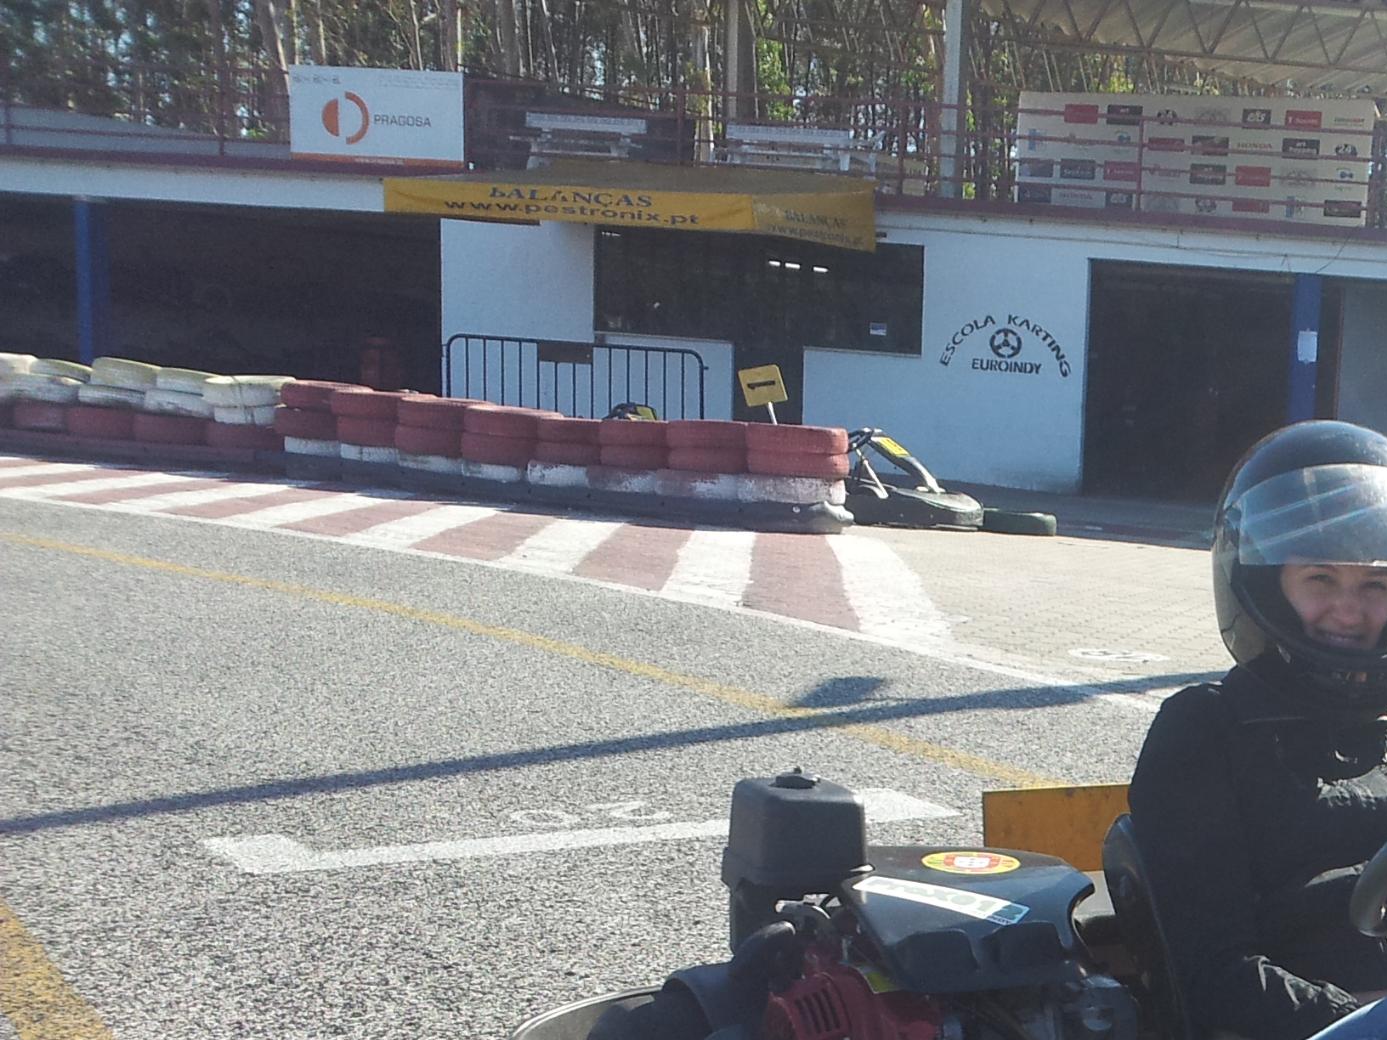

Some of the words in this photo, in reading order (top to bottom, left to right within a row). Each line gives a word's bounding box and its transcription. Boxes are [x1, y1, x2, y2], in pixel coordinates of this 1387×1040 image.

[373, 114, 432, 128] PRAGOSA
[443, 199, 700, 226] www.pestronix.pt
[940, 314, 996, 367] ESCOLA
[1007, 313, 1072, 378] KARTING
[971, 358, 1042, 375] EUROINDY
